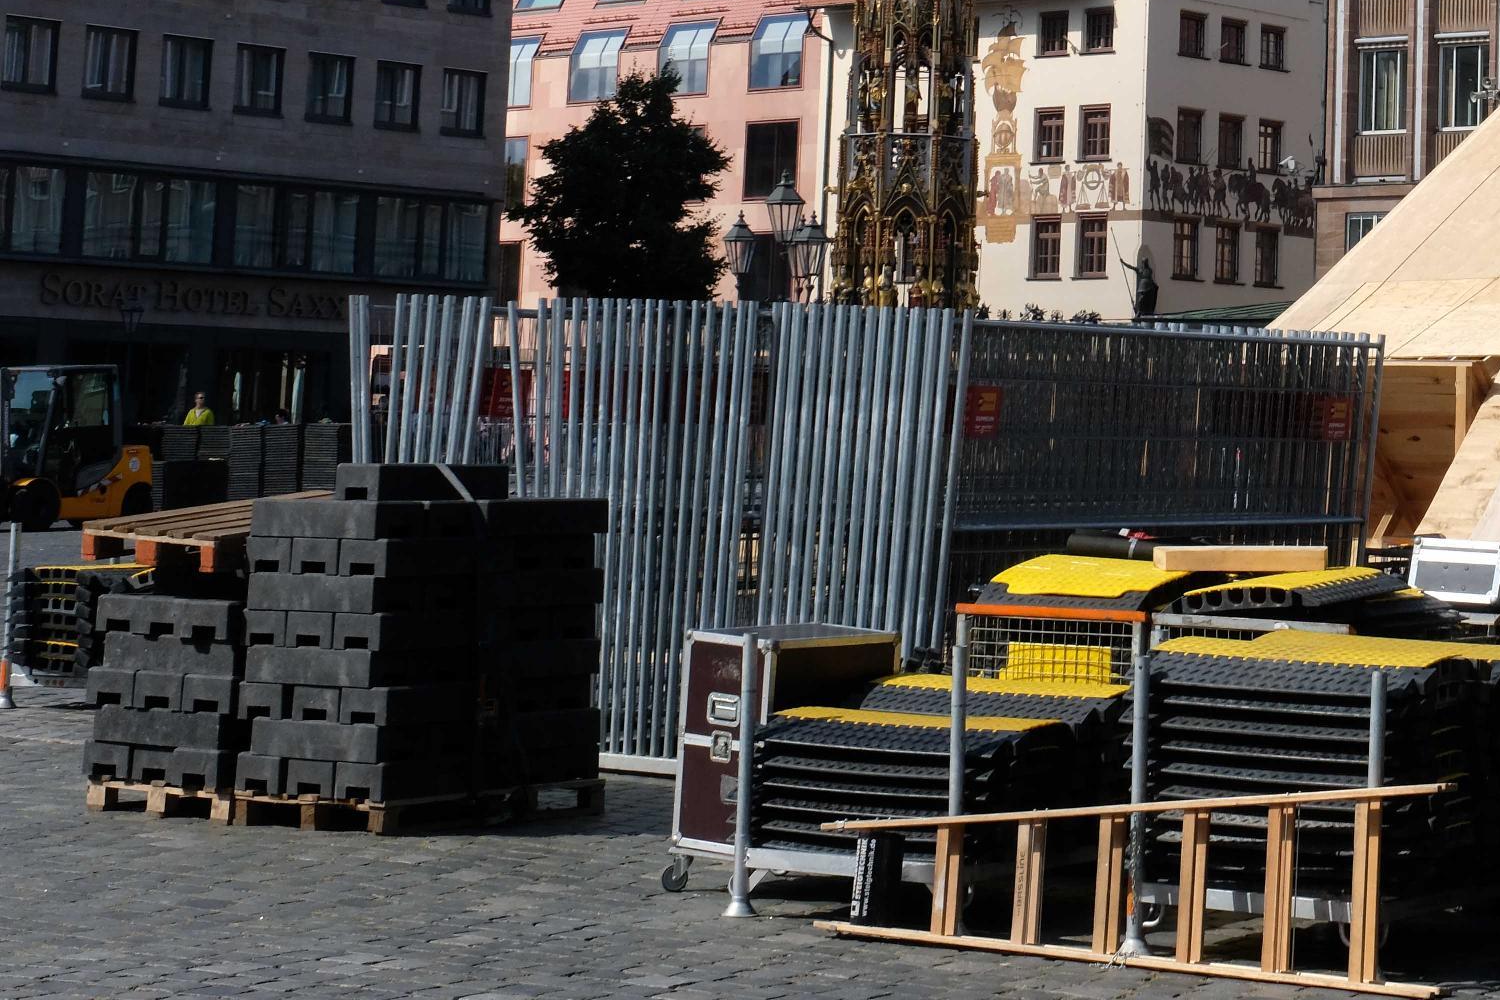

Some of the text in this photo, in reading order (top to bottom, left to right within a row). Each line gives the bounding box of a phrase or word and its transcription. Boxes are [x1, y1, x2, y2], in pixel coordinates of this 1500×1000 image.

[151, 278, 257, 315] HOTEL
[855, 838, 868, 900] STEIGTECHNIK
[862, 838, 877, 917] www.steigtechnik.de
